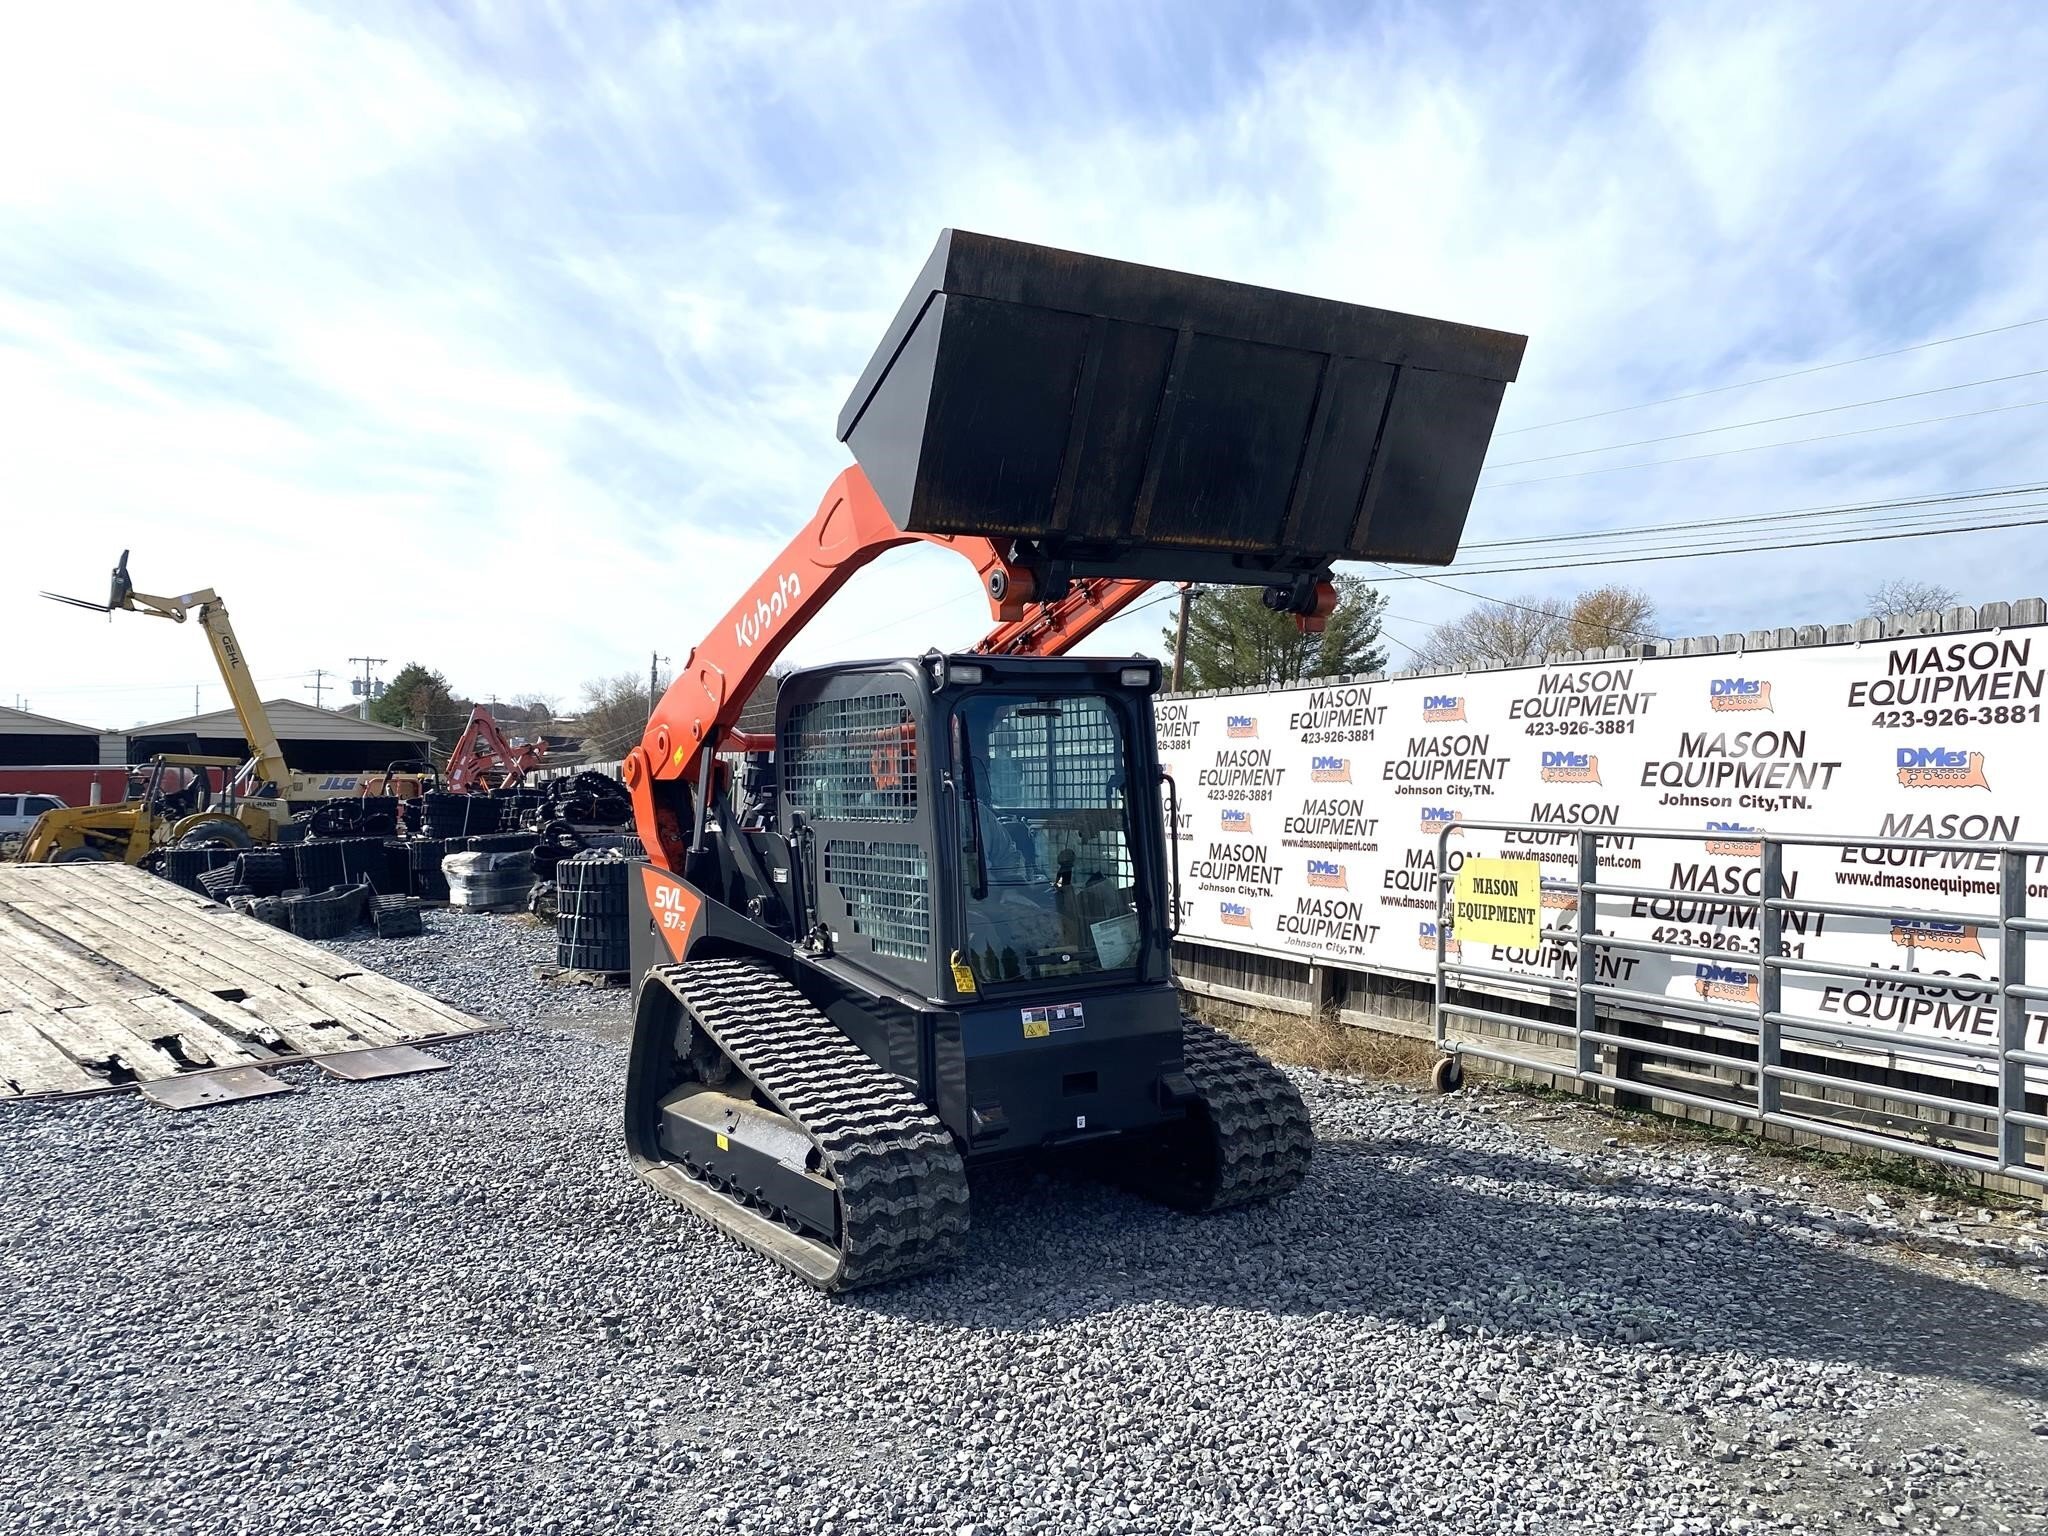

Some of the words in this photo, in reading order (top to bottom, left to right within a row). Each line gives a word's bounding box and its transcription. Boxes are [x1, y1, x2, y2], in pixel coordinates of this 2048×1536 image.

[735, 572, 801, 648] Kubota
[222, 635, 239, 669] GEHL
[1888, 638, 2031, 676] MASON
[1537, 669, 1633, 695] MASON
[1848, 669, 2048, 707] EQUIPMEN
[1309, 687, 1371, 710] MASON
[1508, 692, 1657, 719] EQUIPMENT
[1154, 705, 1188, 721] ASON
[1290, 706, 1387, 730] EQUIPMENT
[1872, 704, 2040, 728] 423-926-3881
[1156, 721, 1200, 737] PMENT
[1301, 729, 1375, 744] 423-926-3881
[1525, 719, 1635, 736] 423-926-3881
[1158, 739, 1191, 750] 26-3881
[1407, 734, 1489, 757] MASON
[1678, 730, 1806, 758] MASON
[1215, 749, 1271, 767] MASON
[1383, 758, 1510, 780] EQUIPMENT
[319, 777, 358, 790] JLG
[1198, 768, 1285, 786] EQUIPMENT
[1640, 761, 1842, 790] EQUIPMENT
[1207, 789, 1272, 801] 423-926-3881
[1395, 785, 1442, 795] Johnson
[1658, 793, 1732, 807] Johnson
[1302, 799, 1364, 816] MASON
[1530, 803, 1620, 825] MASON
[1284, 817, 1378, 837] EQUIPMENT
[1880, 813, 2020, 841] MASON
[1209, 843, 1267, 863] MASON
[1282, 838, 1378, 852] www.dmasonequipment.com
[1405, 848, 1480, 871] MAO
[1190, 861, 1283, 885] EQUIPMENT
[654, 885, 686, 912] SVL
[1198, 882, 1235, 894] Johnson
[1473, 878, 1518, 897] MASON
[1296, 897, 1363, 921] MASON
[1457, 902, 1536, 925] EQUIPMENT
[663, 911, 686, 931] 97-2
[1276, 914, 1380, 944] EQUIPMENT
[1284, 937, 1322, 949] Johnson
[1651, 926, 1805, 959] 423-926-381
